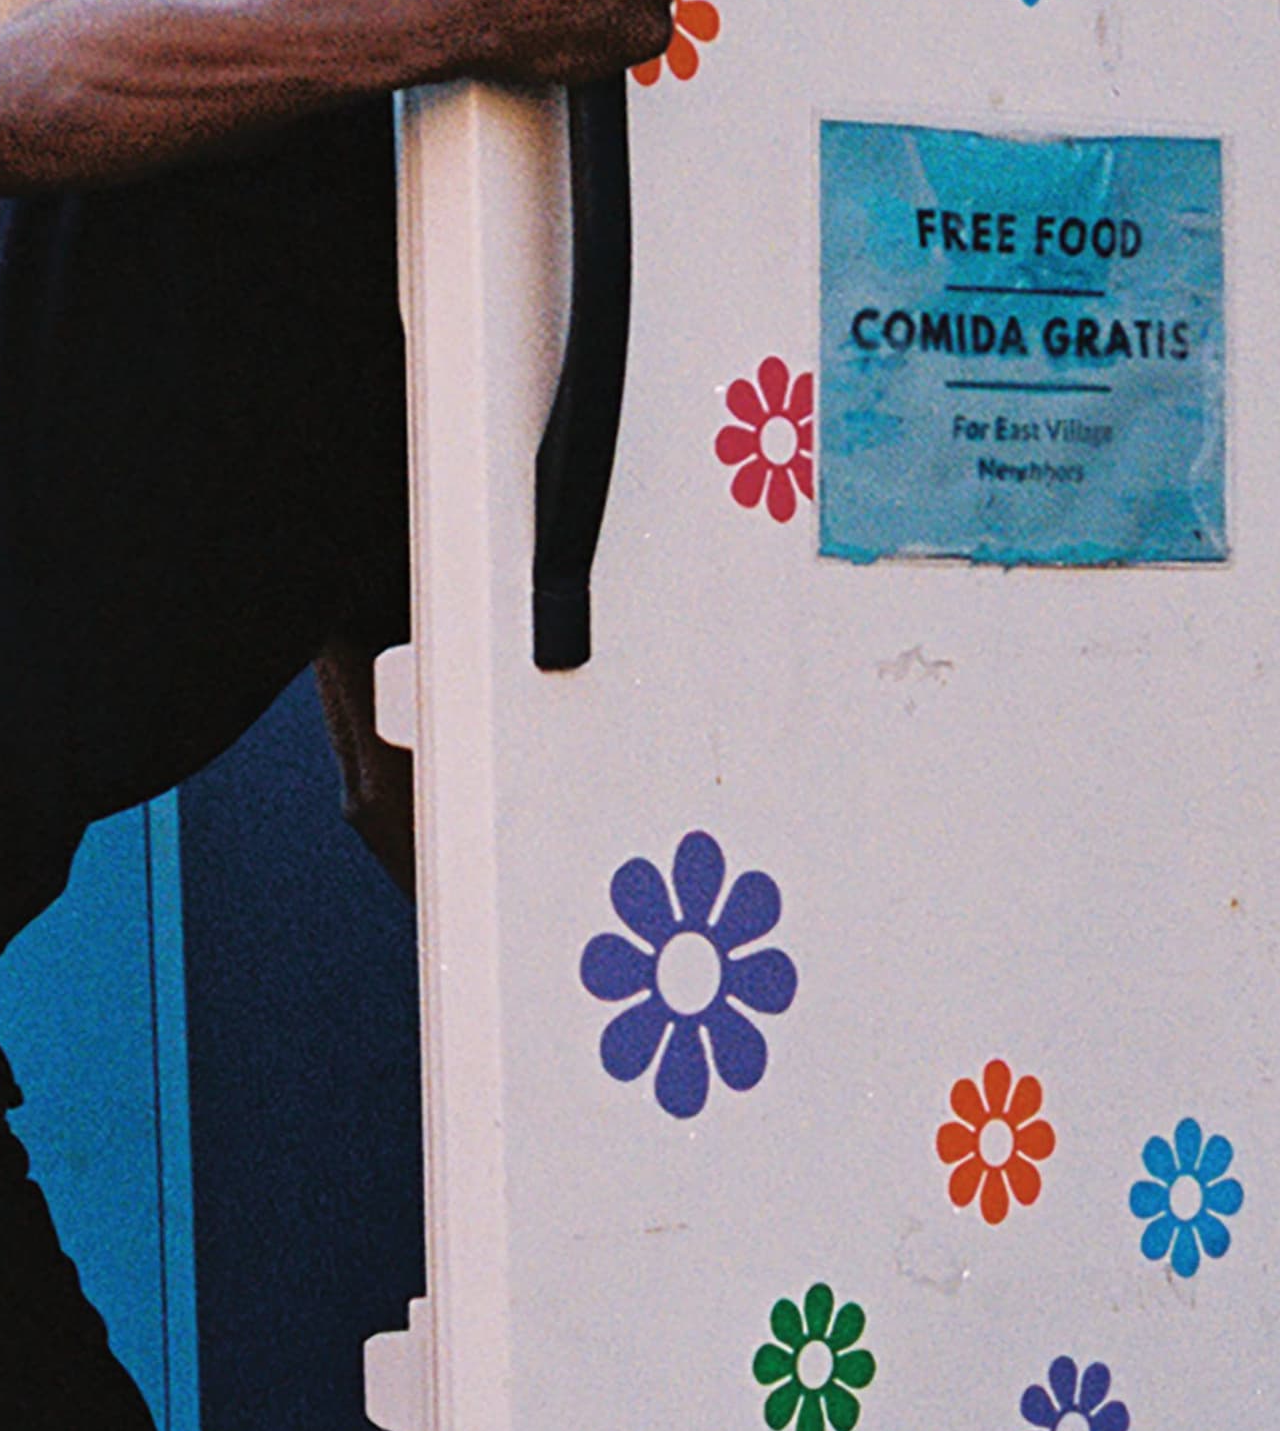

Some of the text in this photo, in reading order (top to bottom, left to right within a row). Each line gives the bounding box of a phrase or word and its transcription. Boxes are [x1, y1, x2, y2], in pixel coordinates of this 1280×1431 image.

[916, 208, 1143, 259] FREE FOOD
[852, 309, 1191, 361] COMIDA GRATIS
[953, 414, 990, 440] For
[995, 415, 1040, 441] East
